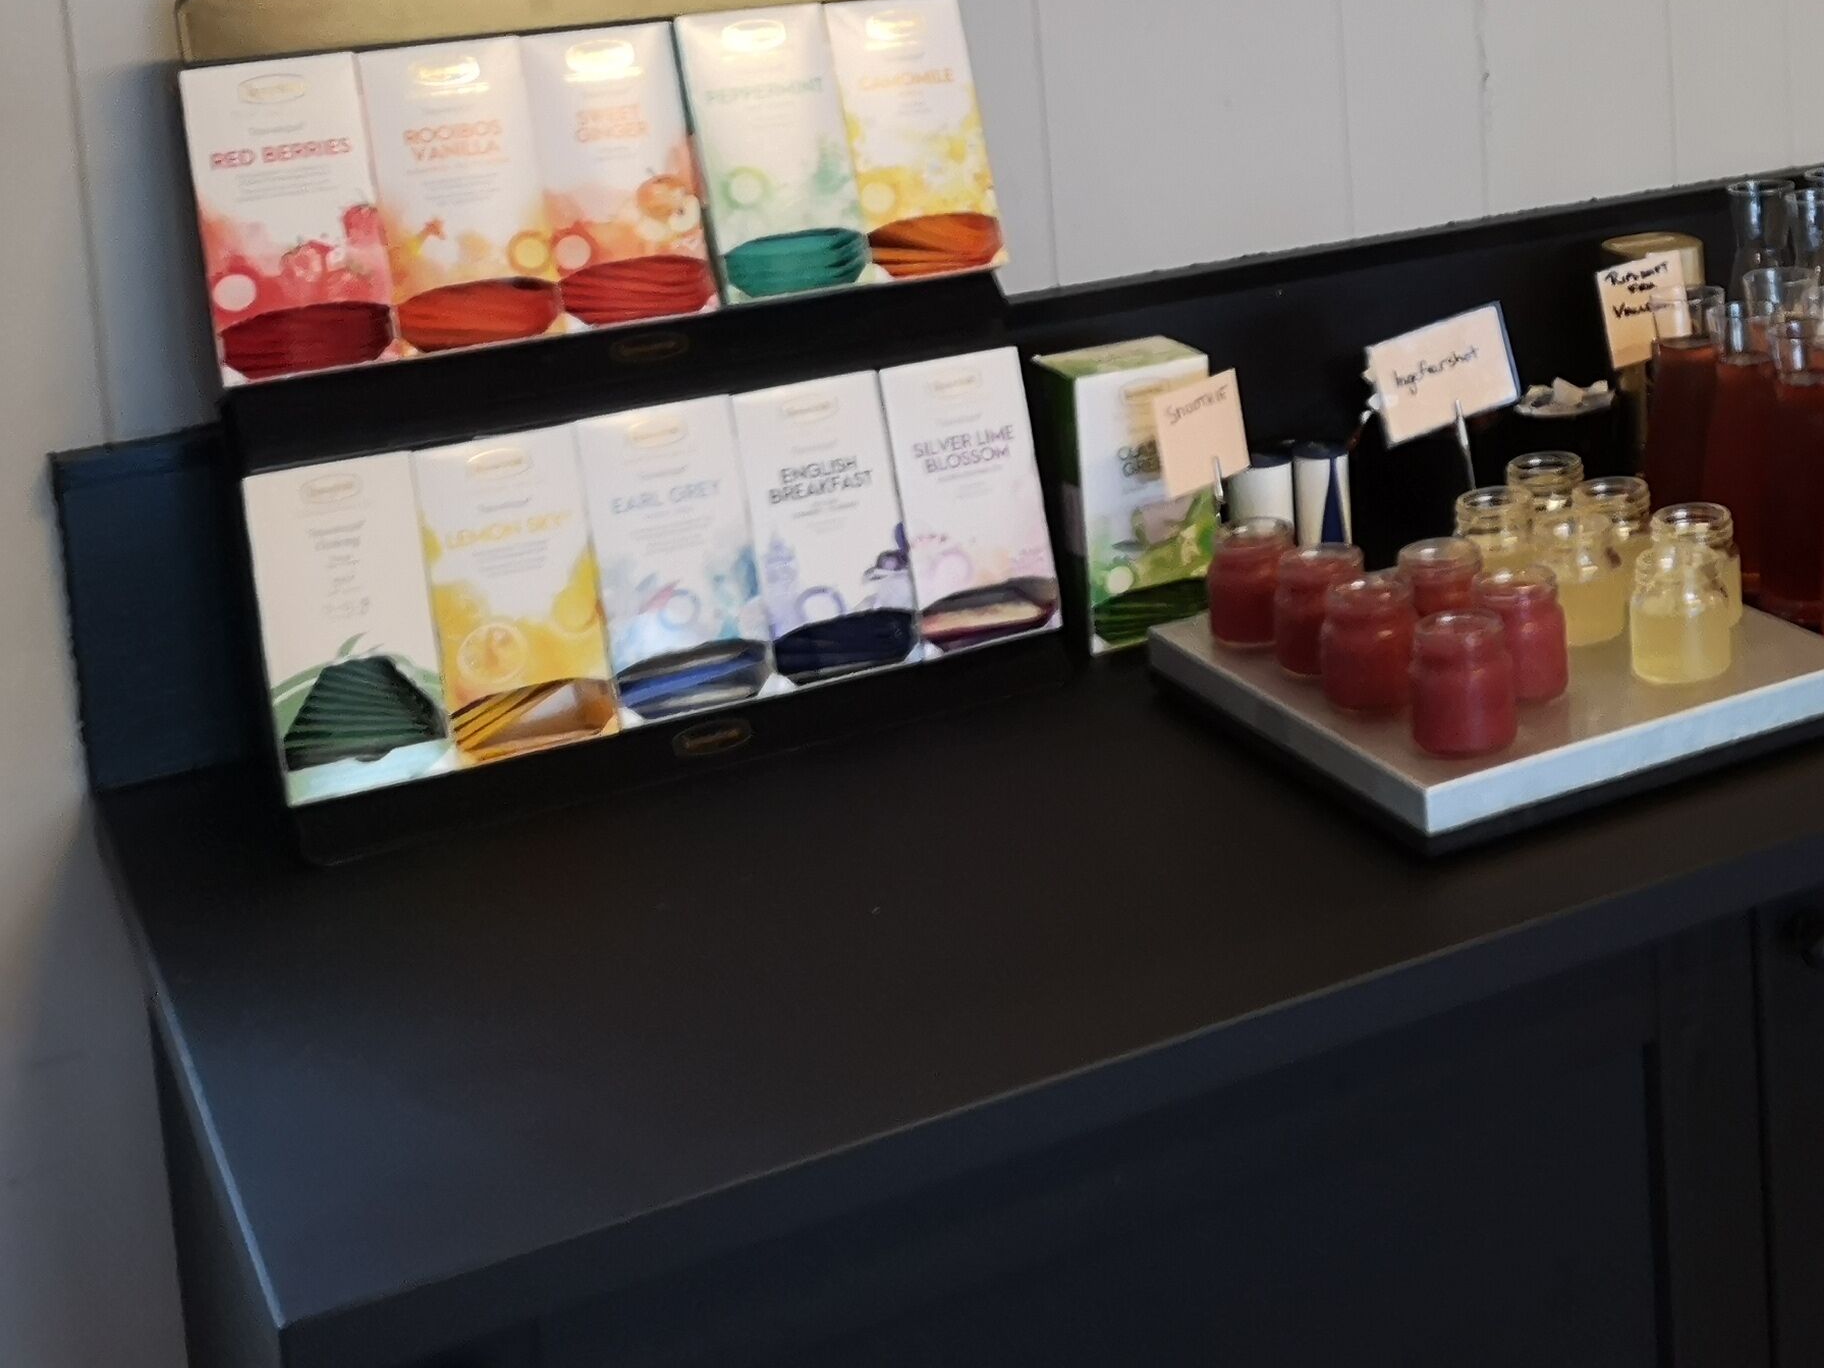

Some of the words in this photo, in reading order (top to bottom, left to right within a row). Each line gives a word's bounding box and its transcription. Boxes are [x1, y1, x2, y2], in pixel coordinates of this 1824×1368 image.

[403, 119, 503, 145] ROOIBOS
[210, 148, 256, 172] RED
[262, 137, 353, 164] BERRIES
[411, 139, 501, 162] VANILLA
[912, 433, 972, 459] SILVER
[976, 424, 1015, 446] LIME
[780, 455, 857, 484] ENGLISH
[925, 445, 1010, 473] BLOSSOM
[610, 493, 662, 514] EARL
[669, 479, 721, 504] GREY
[768, 469, 873, 505] BREAKFAST
[445, 523, 522, 550] LEMON
